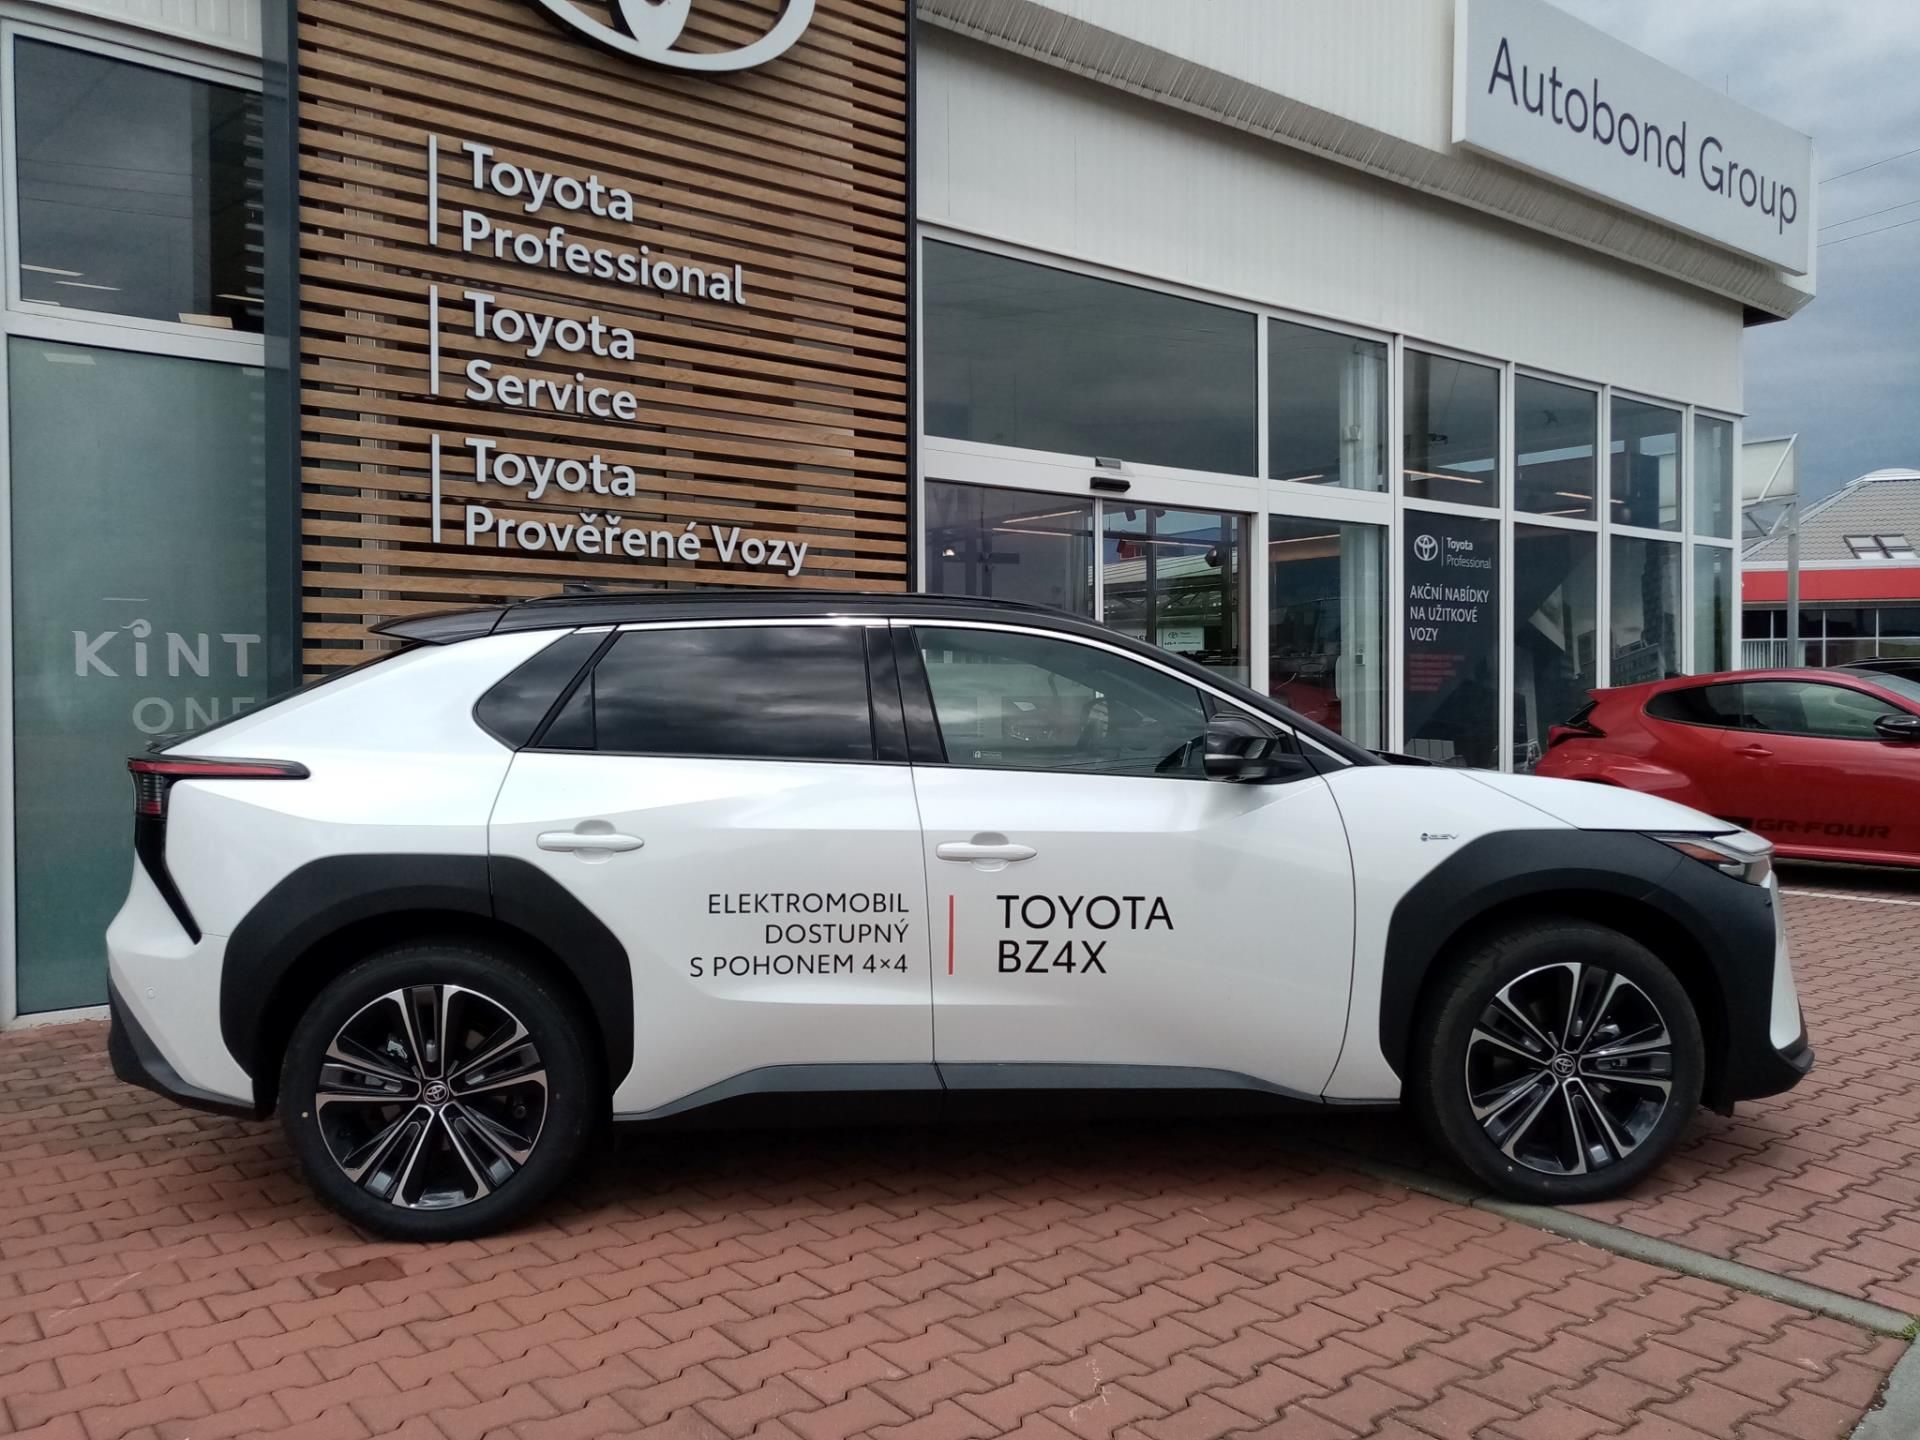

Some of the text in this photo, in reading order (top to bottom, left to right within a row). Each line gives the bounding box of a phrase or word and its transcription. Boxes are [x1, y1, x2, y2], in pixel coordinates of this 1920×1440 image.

[1488, 37, 1797, 234] Autobond Group
[462, 141, 634, 223] Toyota
[462, 210, 746, 305] Professional
[464, 291, 635, 361] Toyota
[465, 359, 638, 420] Service
[465, 437, 637, 499] Toyota
[465, 505, 808, 576] Prověřené Vozy
[1446, 537, 1473, 552] Toyota
[1446, 554, 1492, 569] Professional
[1409, 582, 1489, 603] AKČNÍ NABÍDKY
[1410, 604, 1478, 623] NA UŽITKOVÉ
[1409, 627, 1439, 641] VOZY
[708, 893, 909, 914] ELEKTROMOBIL
[996, 895, 1174, 931] TOYOTA
[765, 918, 909, 944] DOSTUPNÝ
[689, 957, 704, 978] S
[713, 954, 854, 977] POHONEM
[998, 940, 1107, 974] BZ4X
